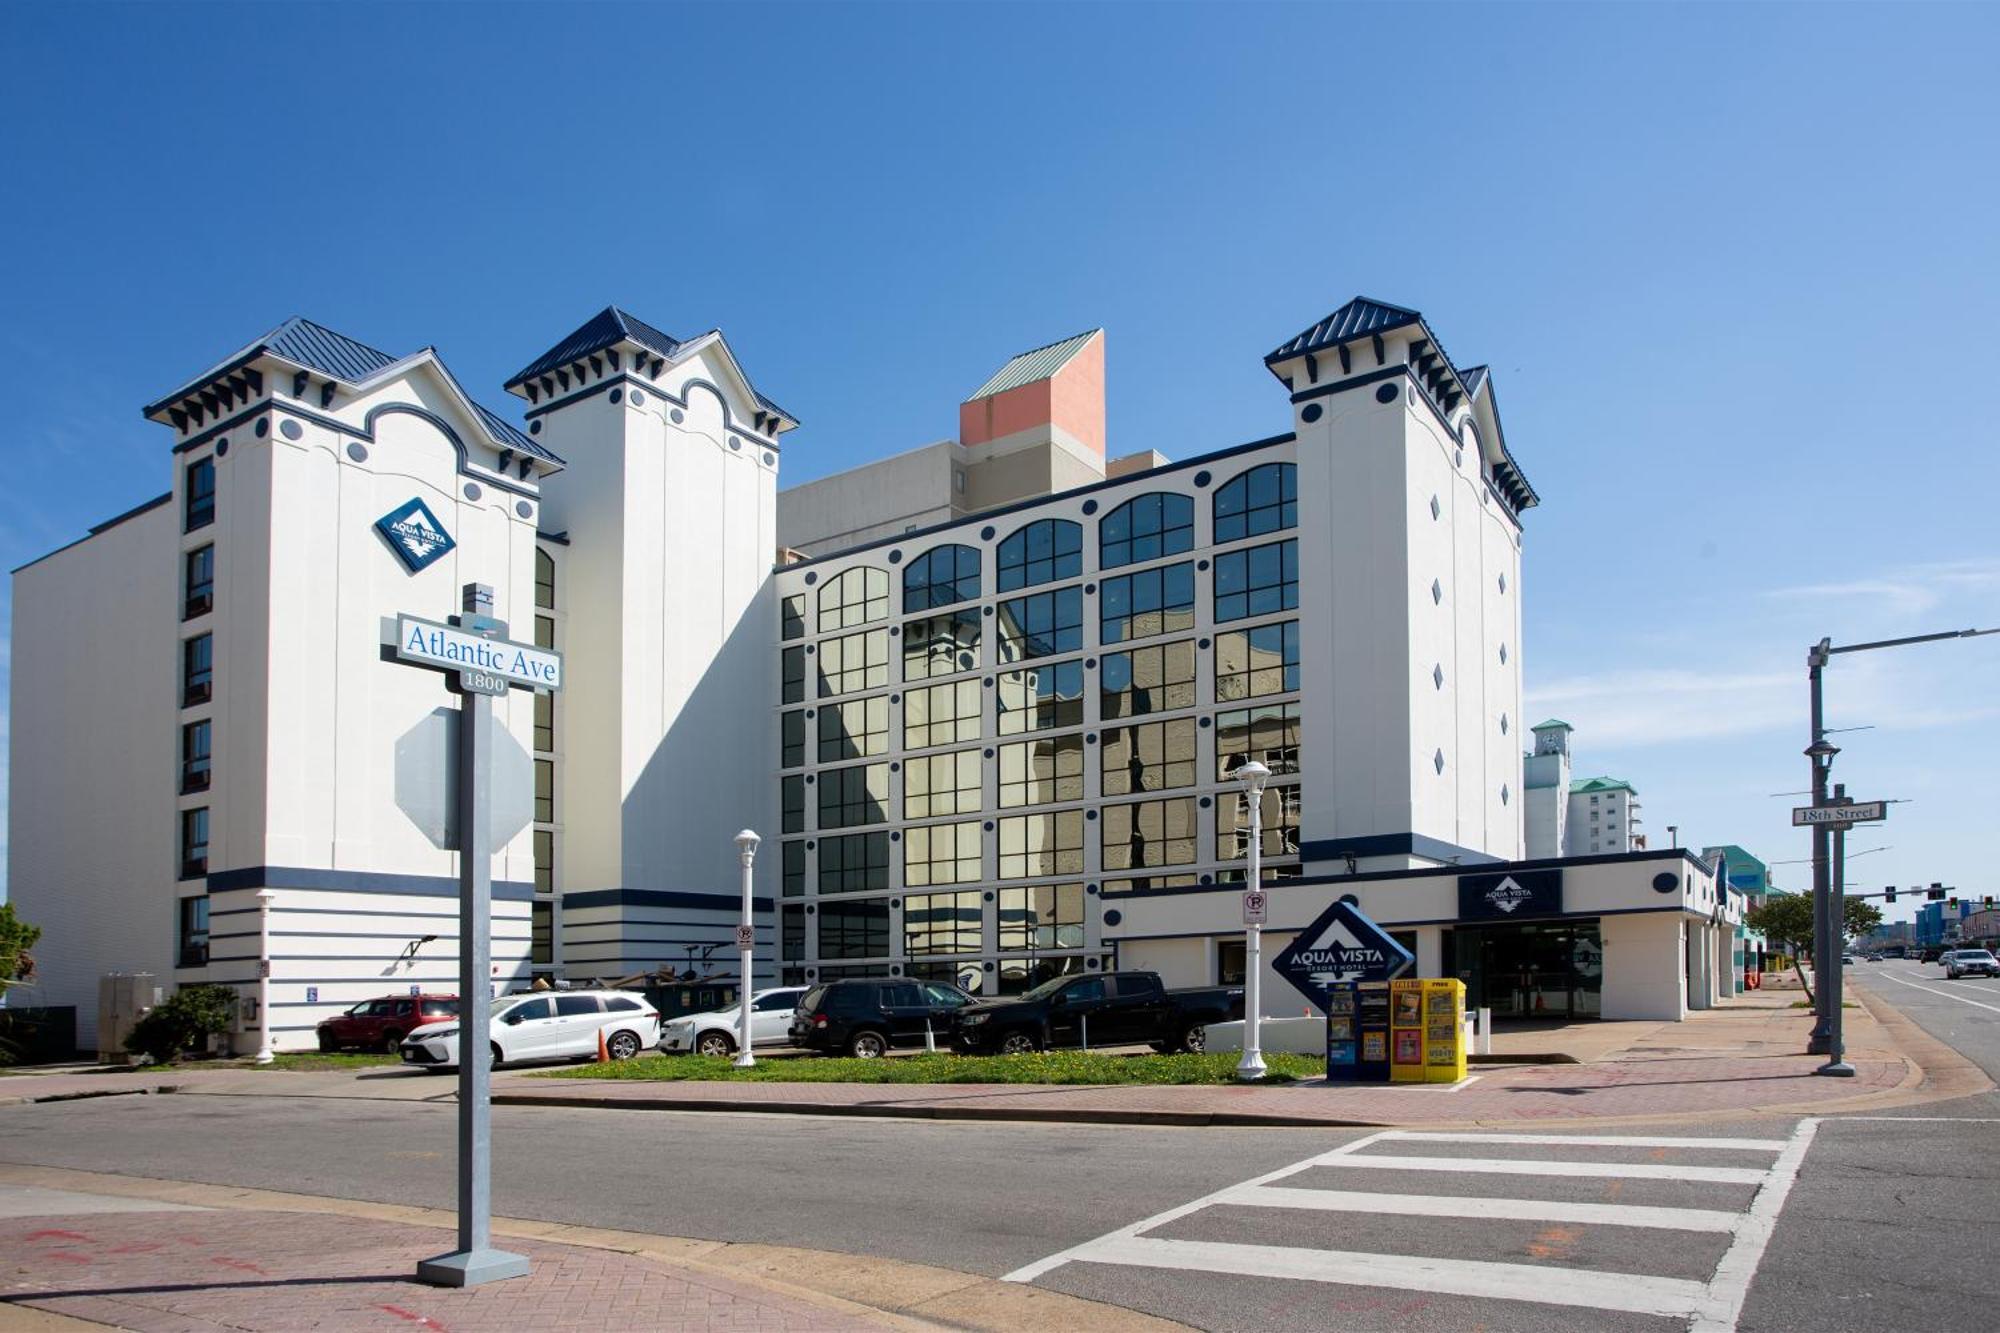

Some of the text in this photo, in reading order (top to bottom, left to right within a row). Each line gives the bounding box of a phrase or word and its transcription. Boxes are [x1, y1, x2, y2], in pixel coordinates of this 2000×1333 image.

[391, 521, 419, 536] AQUA
[420, 529, 446, 545] VISTA
[407, 626, 556, 682] Atlantic Ave
[466, 672, 504, 692] 1800
[1802, 807, 1873, 821] 18th Street
[1290, 950, 1384, 966] AQUA VISTA
